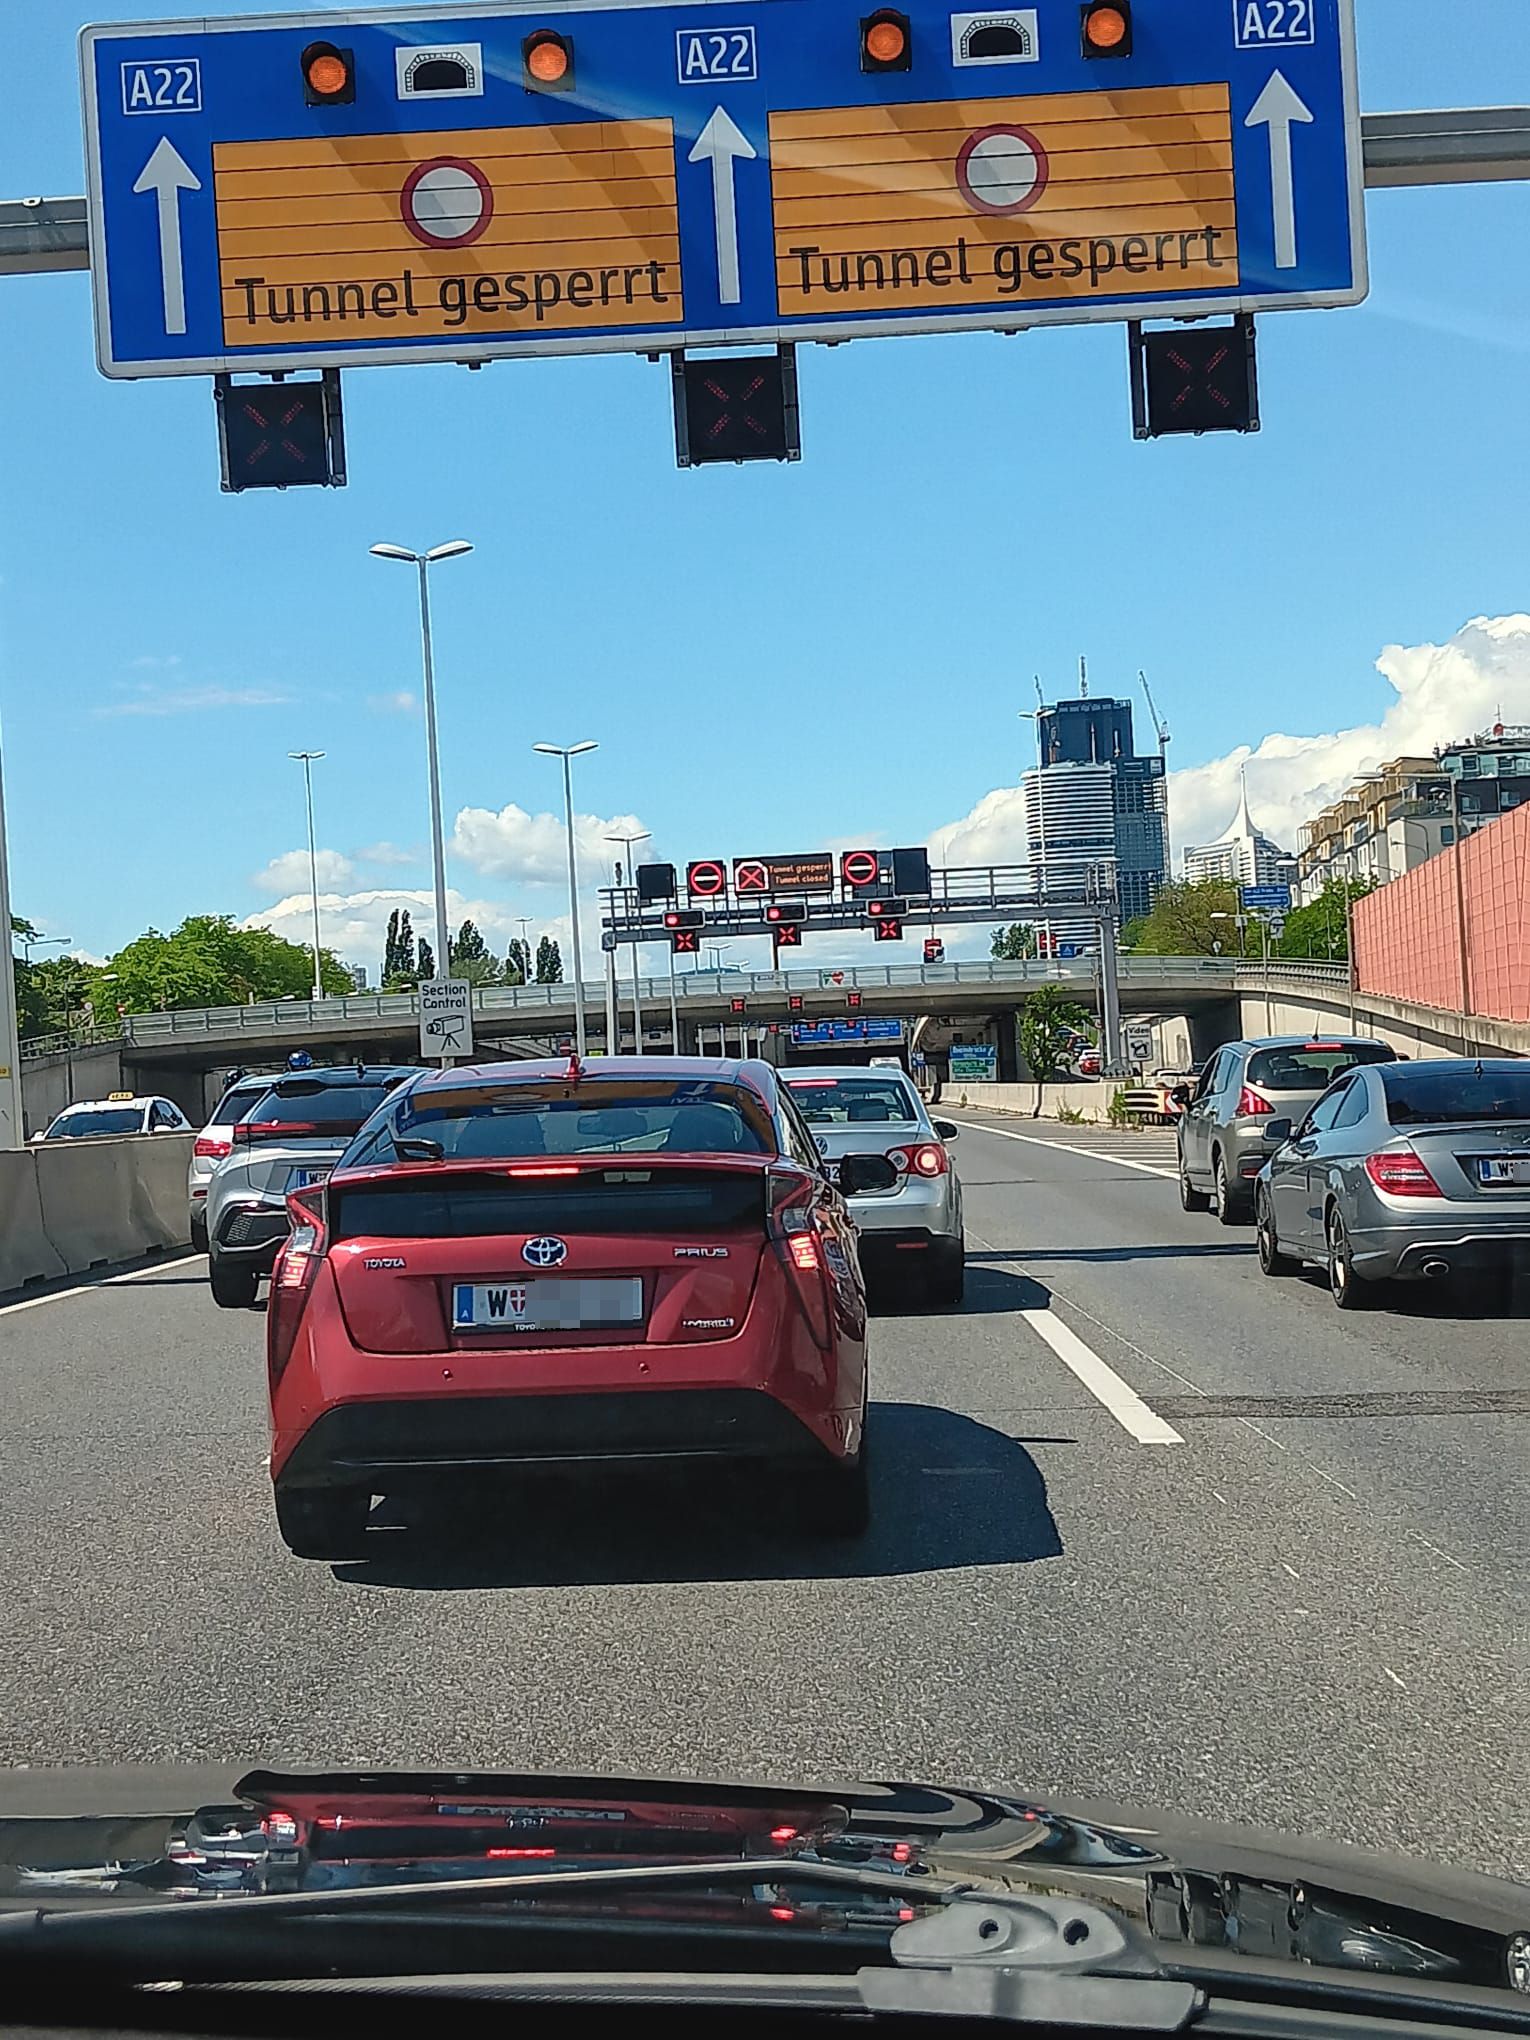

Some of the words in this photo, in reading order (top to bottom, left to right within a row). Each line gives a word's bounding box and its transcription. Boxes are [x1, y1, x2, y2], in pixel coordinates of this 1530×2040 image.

[1243, 0, 1307, 40] A22
[686, 33, 749, 76] A22
[131, 67, 195, 107] A22
[790, 237, 973, 294] Tunnel
[993, 225, 1223, 291] gesperrt
[236, 269, 415, 326] Tunnel
[438, 260, 668, 325] gesperrt
[769, 865, 794, 874] Tunnel
[775, 876, 800, 884] Tunnel
[801, 875, 829, 883] closed
[422, 984, 467, 996] Section
[423, 996, 466, 1009] Control
[674, 1247, 729, 1257] PRIUS
[363, 1257, 406, 1270] TOYOTA
